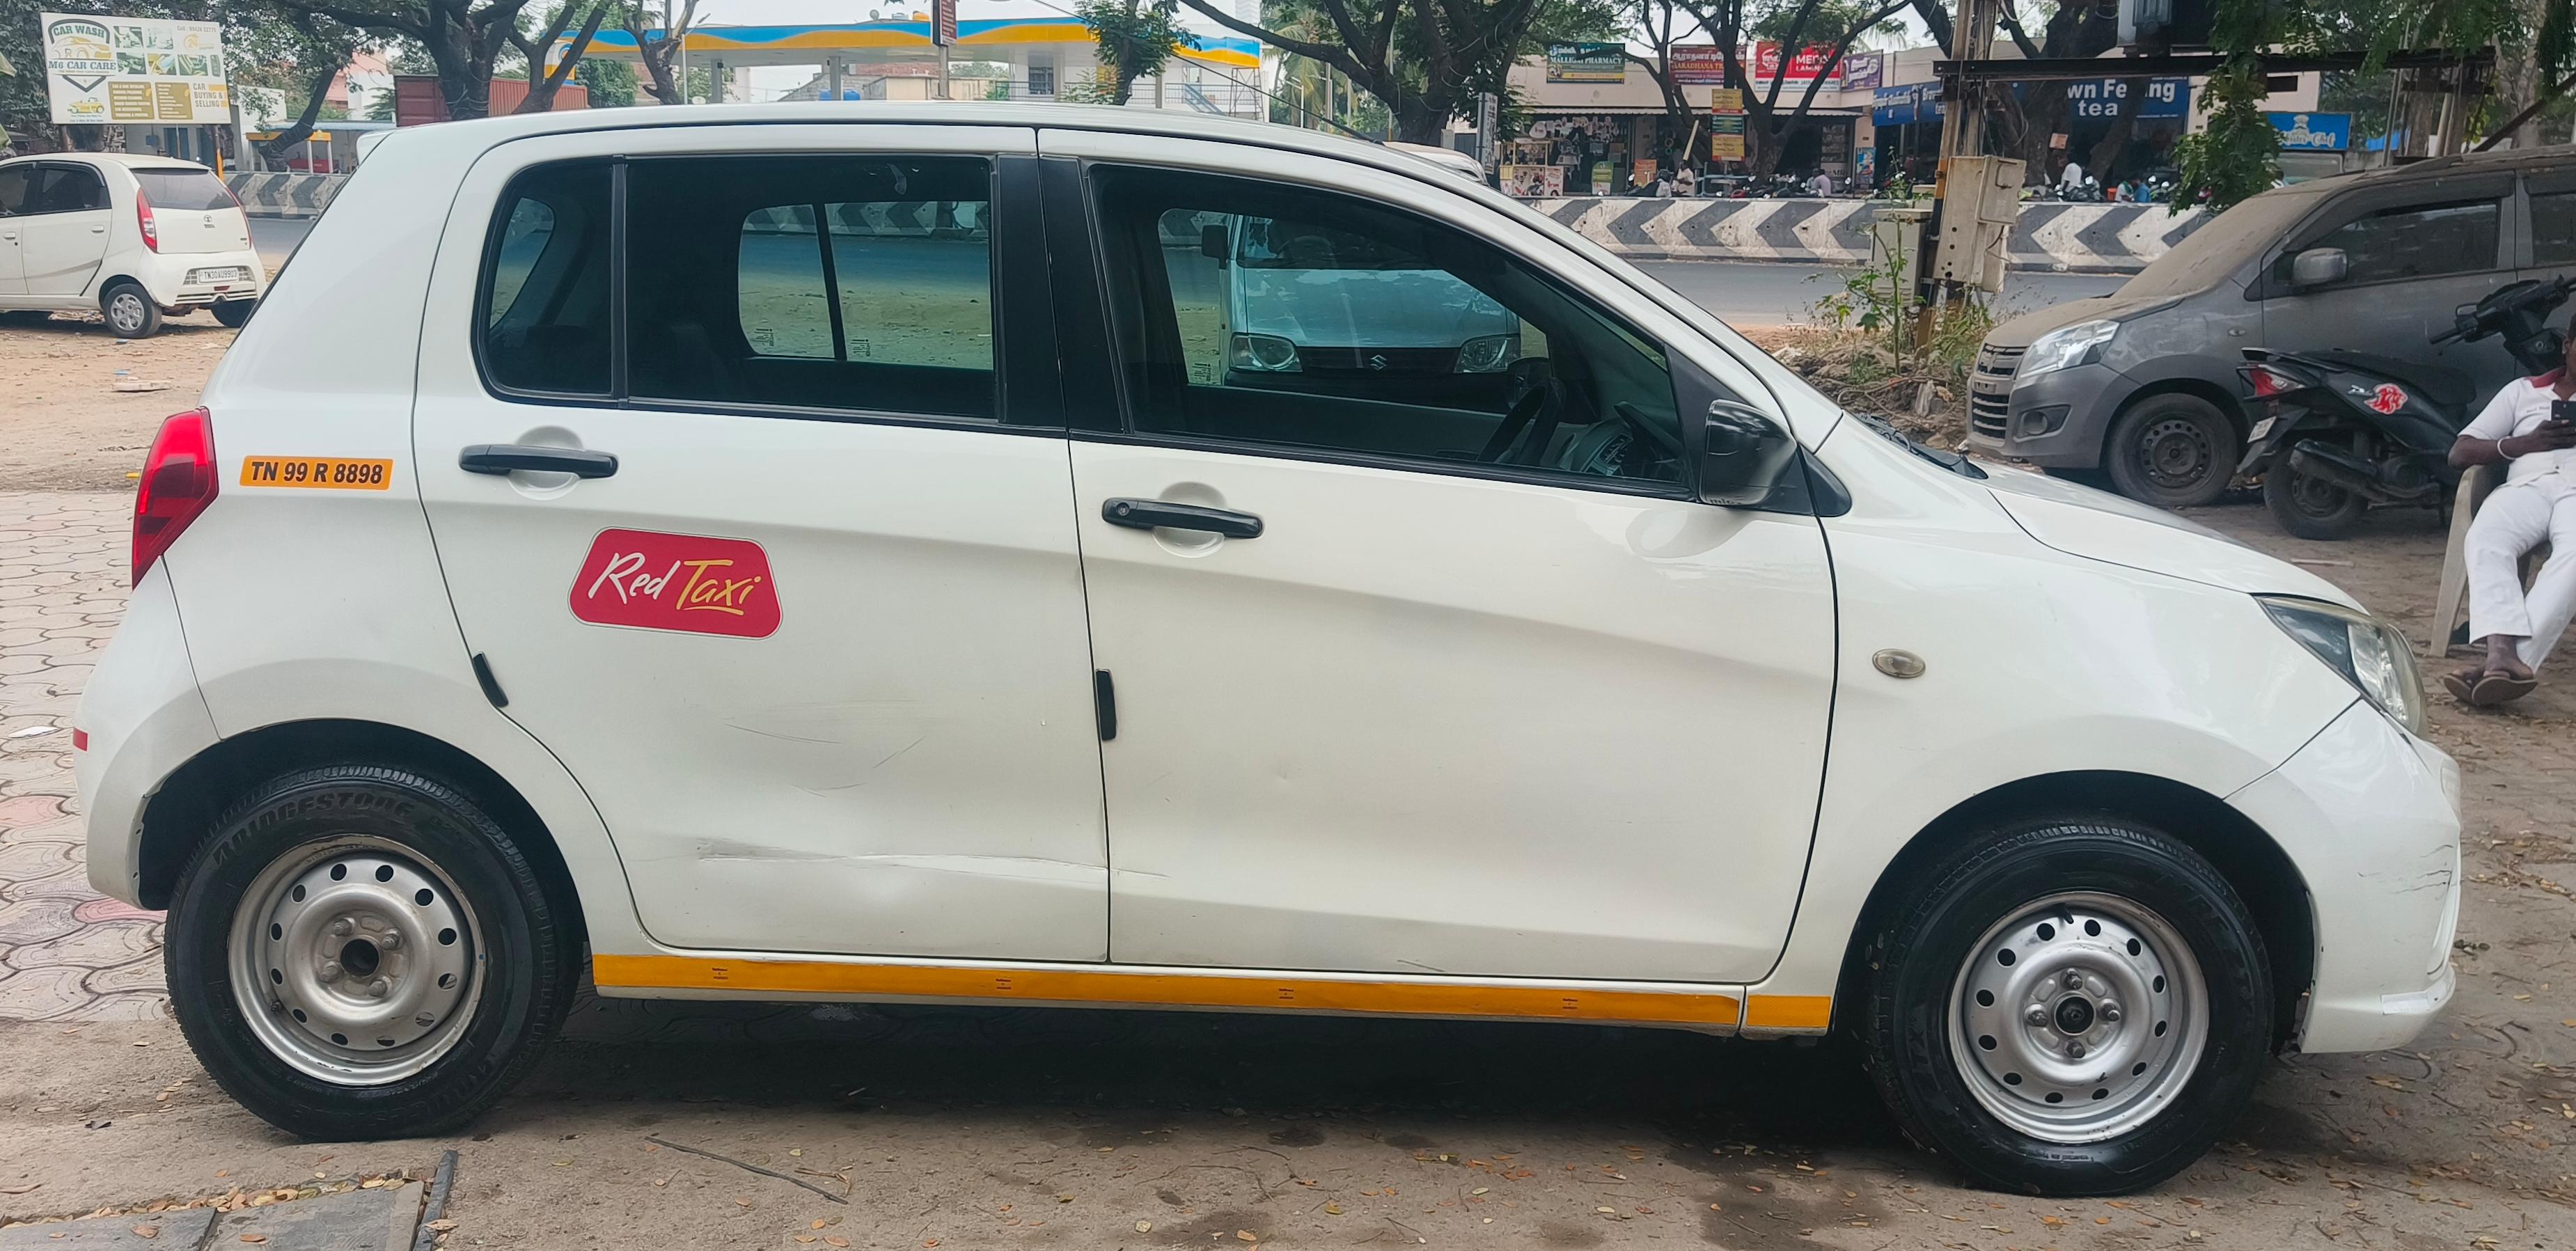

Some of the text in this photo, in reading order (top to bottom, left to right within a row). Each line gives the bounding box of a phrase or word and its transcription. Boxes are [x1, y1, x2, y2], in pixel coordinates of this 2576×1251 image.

[53, 25, 104, 38] CAR WASH
[67, 61, 86, 70] CAR
[90, 61, 117, 70] CARE
[1585, 56, 1622, 65] PHARMACY
[194, 91, 217, 100] BUYING
[195, 100, 220, 108] SELLING
[2078, 100, 2118, 117] tea
[251, 462, 383, 484] TN 99 R 8898
[588, 552, 762, 611] Red Taxi
